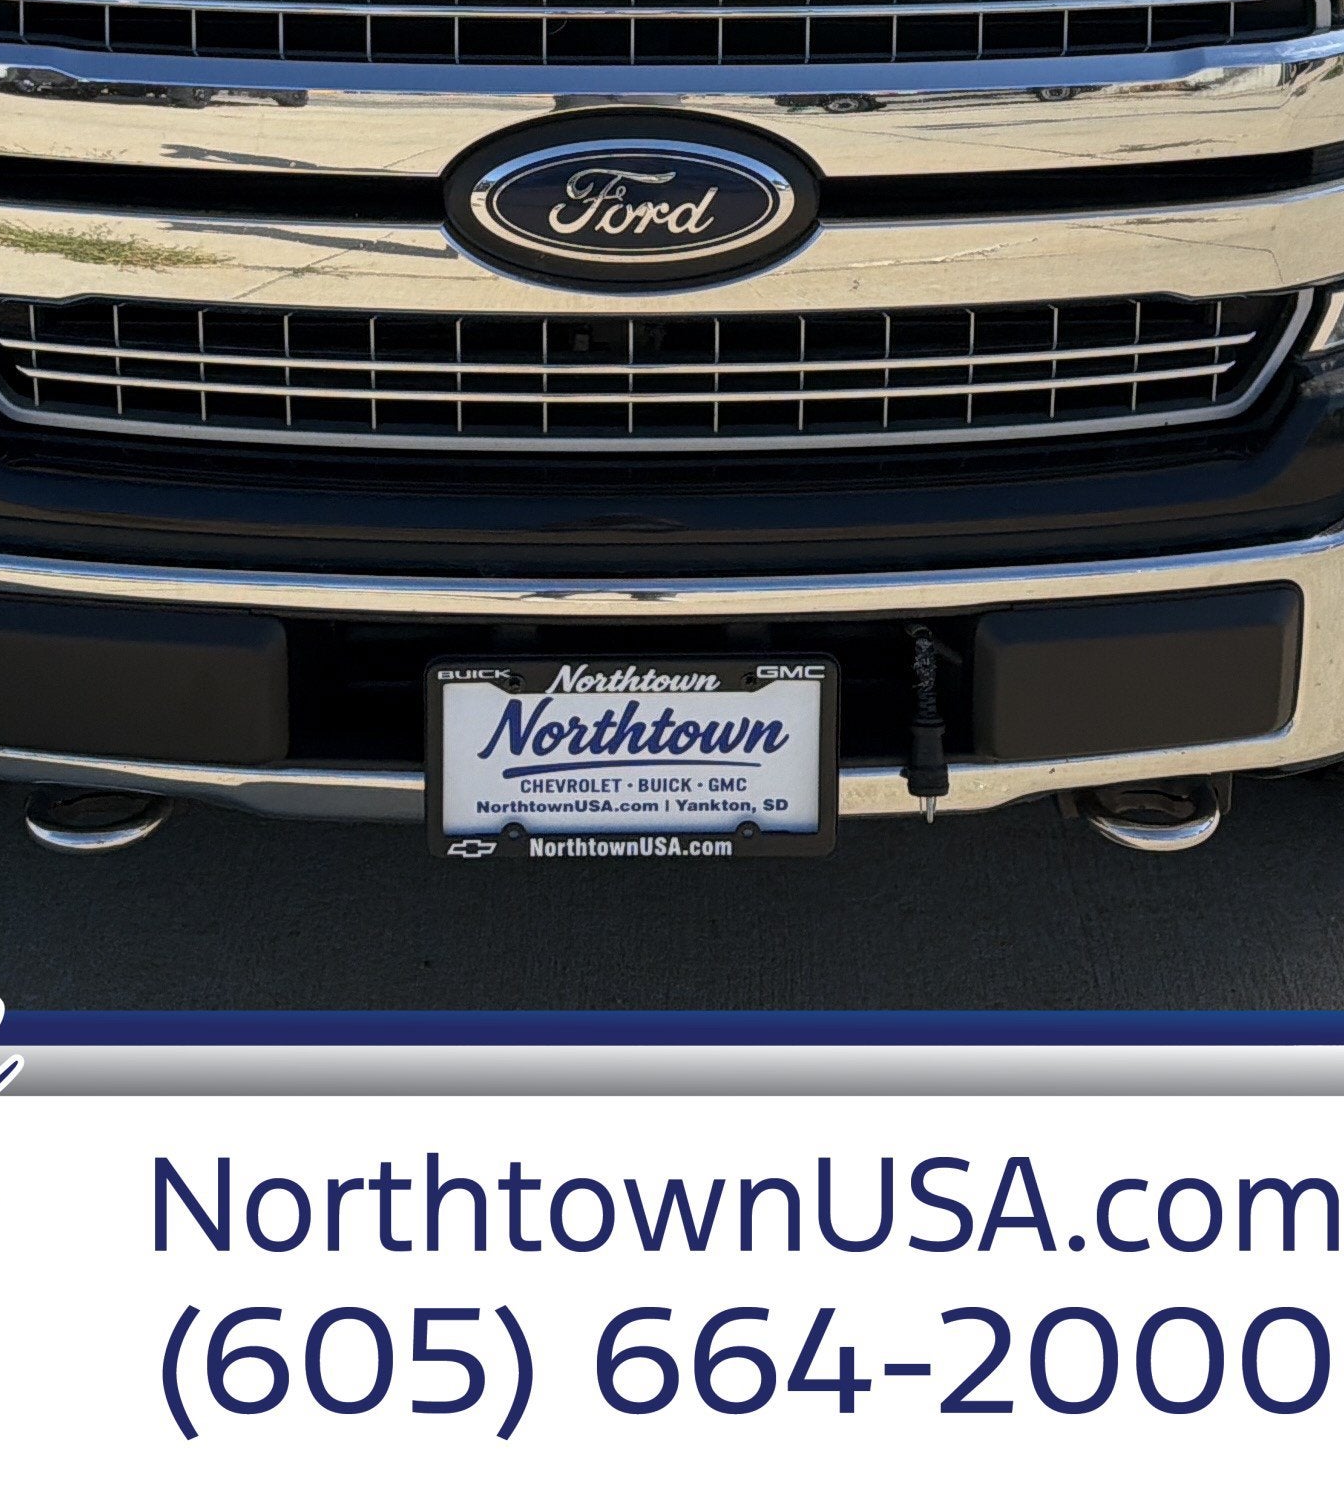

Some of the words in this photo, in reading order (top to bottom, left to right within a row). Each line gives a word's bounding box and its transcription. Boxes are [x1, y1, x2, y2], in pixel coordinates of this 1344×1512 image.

[548, 168, 719, 235] Ford
[437, 669, 512, 681] BUICK
[545, 663, 721, 694] Northtown
[756, 665, 826, 679] GMC
[476, 696, 790, 760] Northtown
[520, 778, 622, 794] CHEVROLET
[638, 777, 693, 793] BUICK
[708, 777, 748, 792] GMC
[476, 799, 659, 814] NorthtownUSA.com
[676, 798, 757, 814] Yankton,
[762, 798, 789, 812] SD
[529, 836, 733, 858] NorthtownUSA.com
